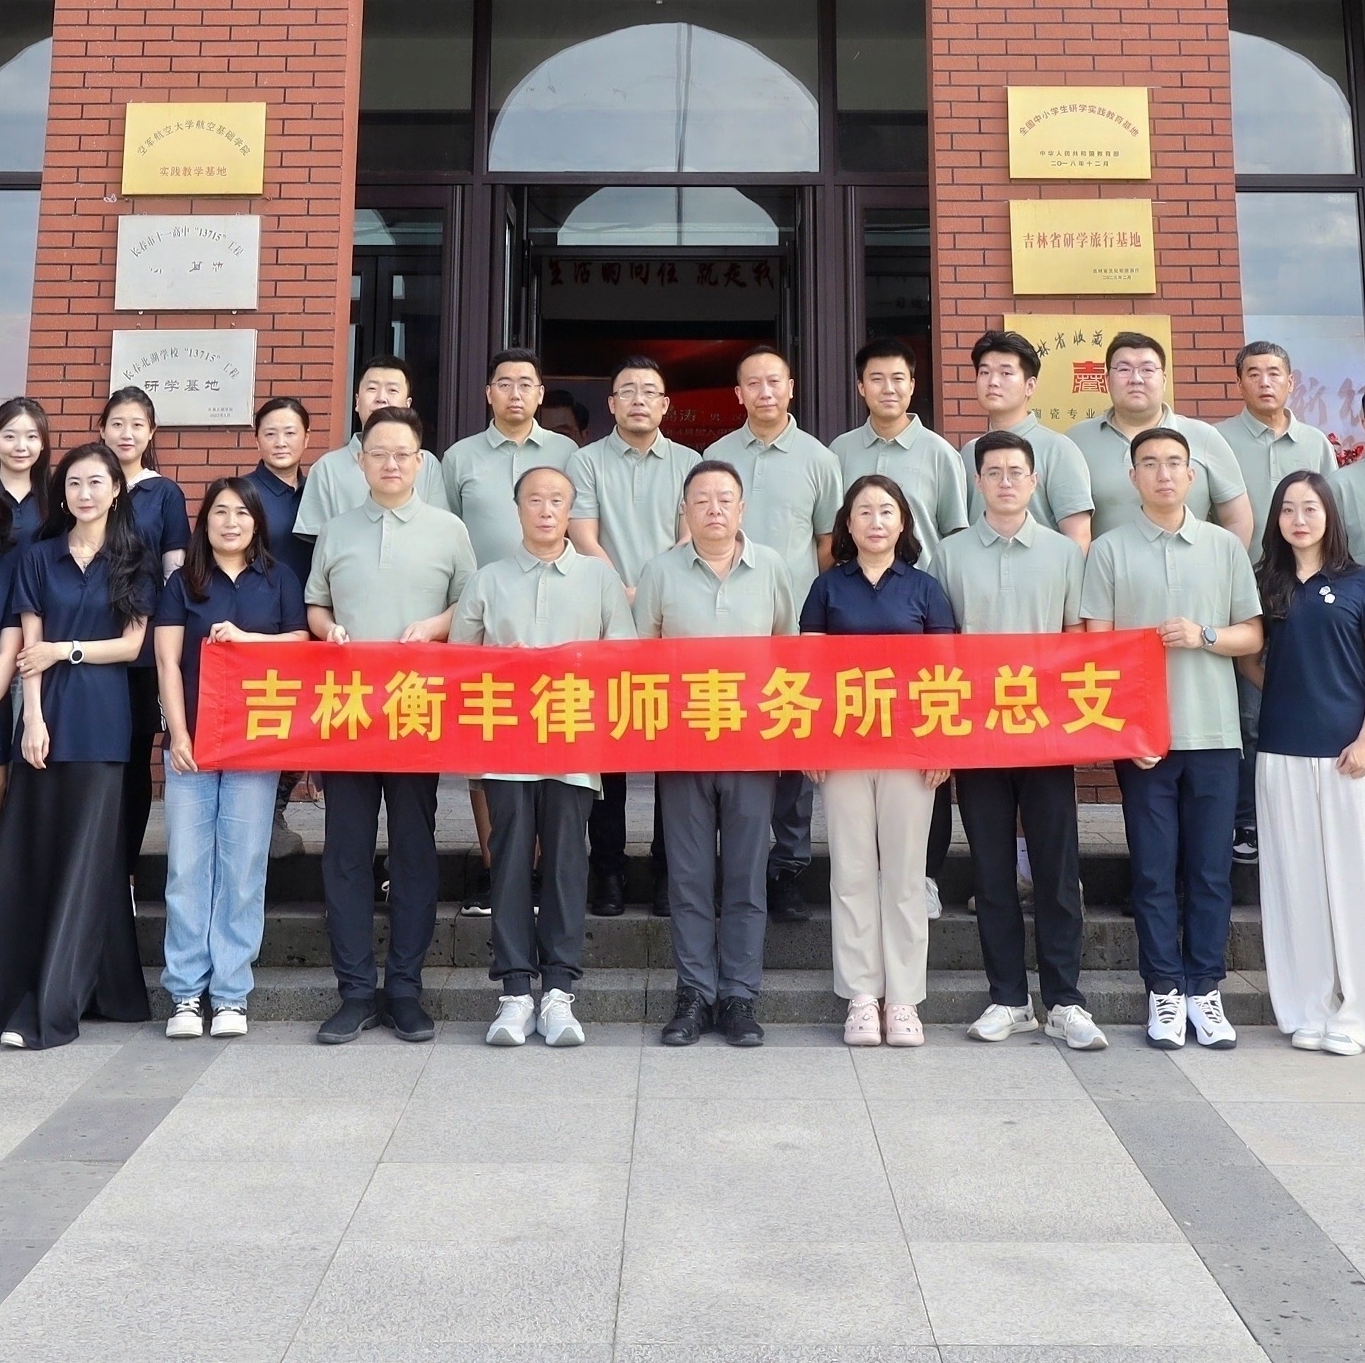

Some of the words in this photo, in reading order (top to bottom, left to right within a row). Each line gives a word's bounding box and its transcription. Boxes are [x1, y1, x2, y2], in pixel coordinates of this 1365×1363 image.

[1019, 103, 1139, 137] 全国中小学生研学实践教育基地
[137, 119, 251, 156] 空军航空大学航空基础学院
[159, 166, 228, 177] 实践教学基地
[1022, 231, 1142, 249] 吉林省研学旅行基地
[143, 379, 221, 392] 研学基地
[241, 660, 1126, 743] 吉林衡丰律师事务所党总支
